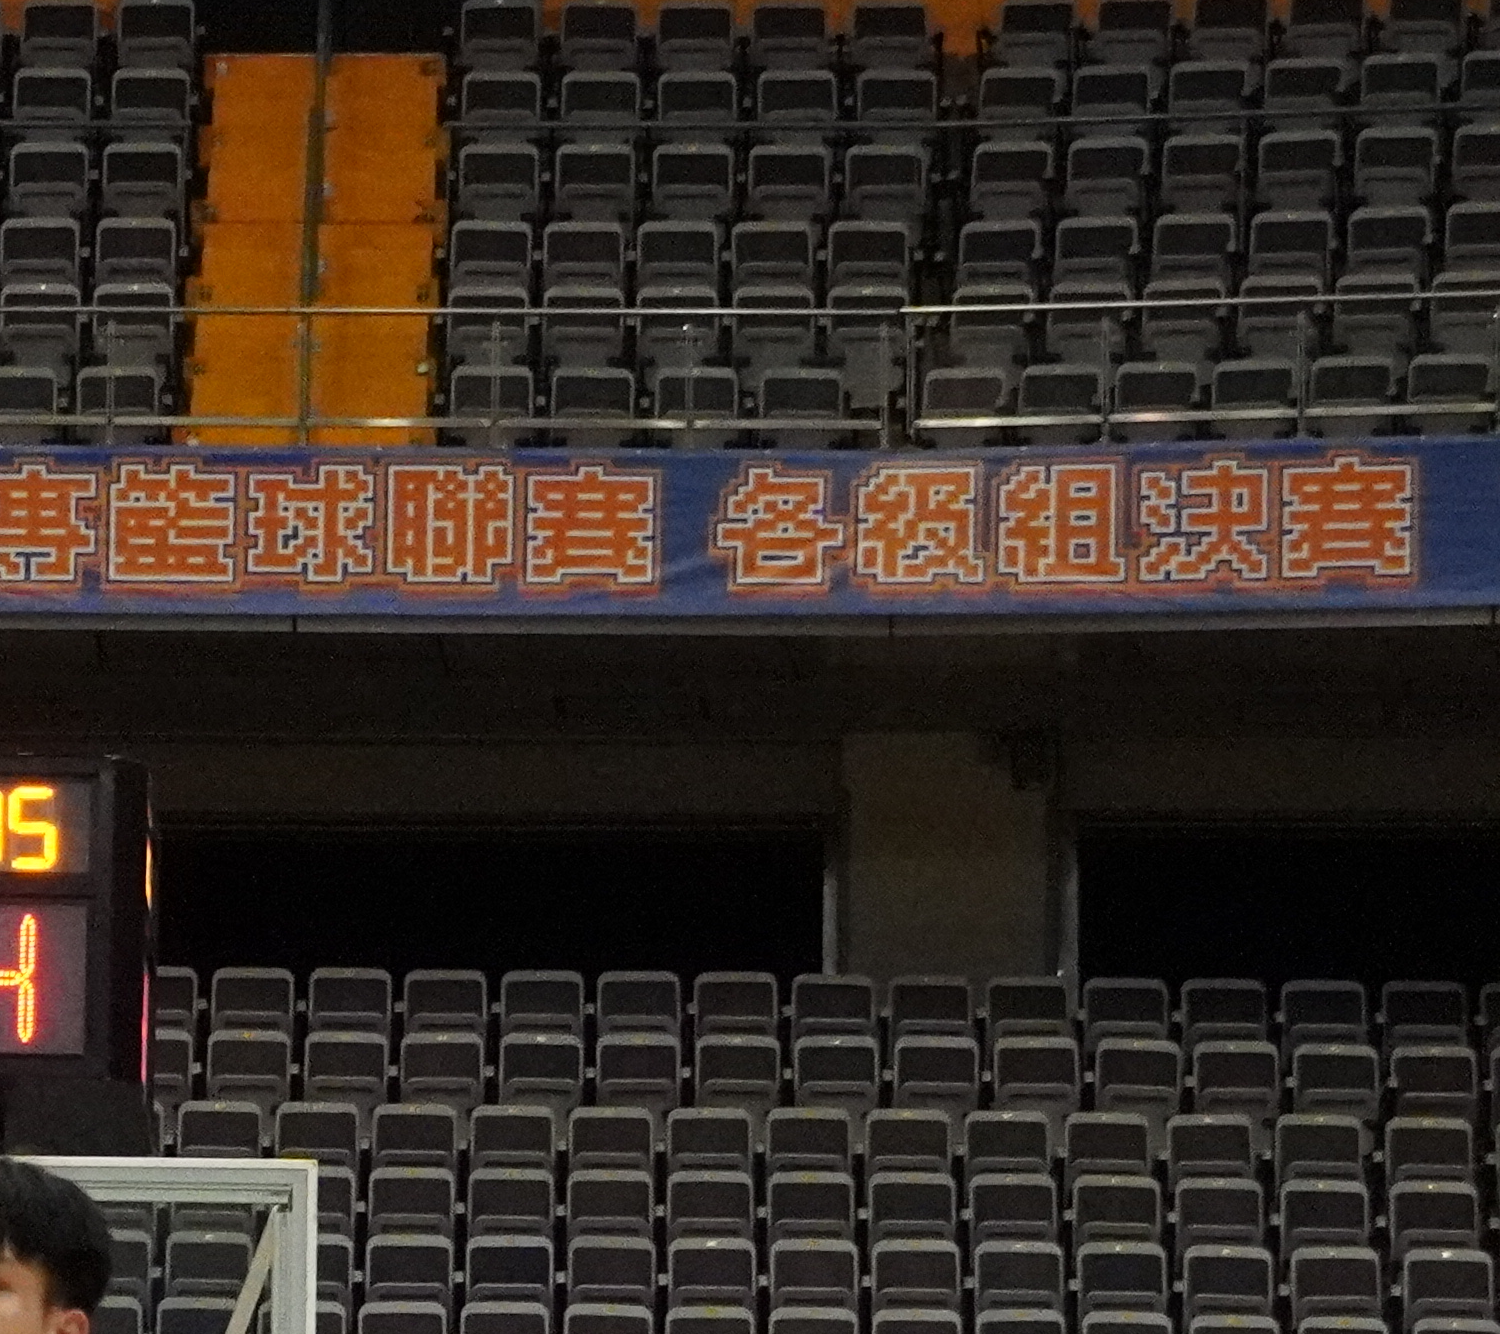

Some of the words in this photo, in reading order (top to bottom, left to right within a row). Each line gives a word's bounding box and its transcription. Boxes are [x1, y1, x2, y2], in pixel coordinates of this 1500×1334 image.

[714, 455, 1414, 584] 各級組決賽
